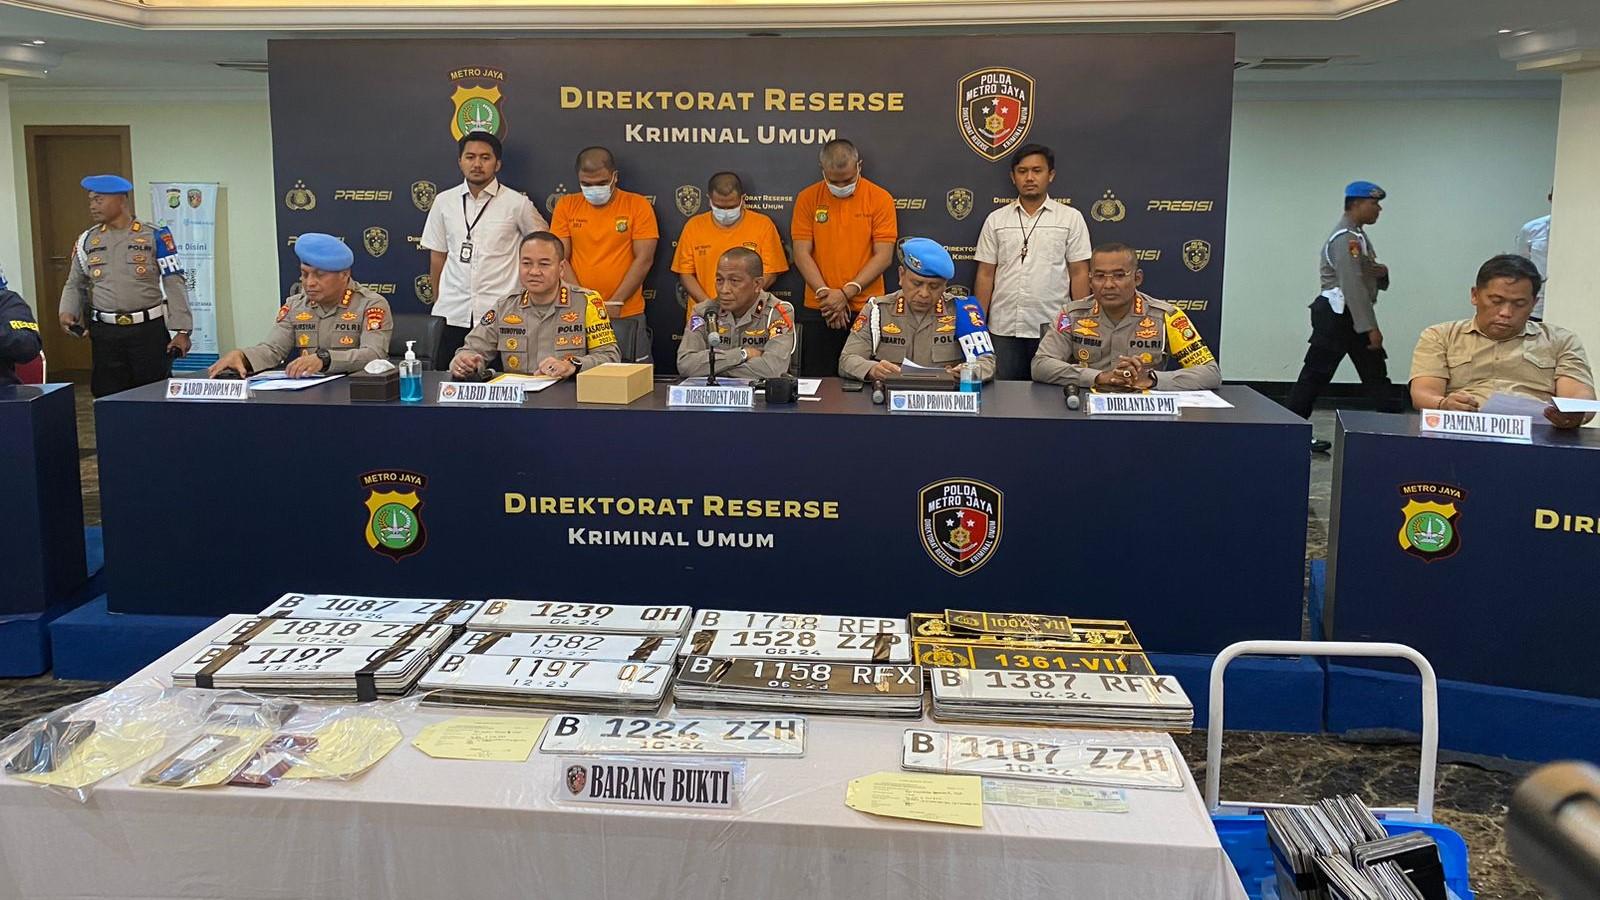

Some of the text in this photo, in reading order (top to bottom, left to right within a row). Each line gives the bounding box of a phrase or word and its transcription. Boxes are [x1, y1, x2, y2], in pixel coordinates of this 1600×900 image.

[450, 68, 504, 81] METRO JAYA
[981, 73, 1011, 85] POLDA
[560, 86, 904, 112] DIREKTORAT RESERSE
[966, 84, 1025, 101] METRO JAYA
[624, 123, 837, 145] KRIMINAL UMUM
[334, 190, 393, 201] PRESISI
[892, 199, 927, 210] SISI
[1147, 200, 1214, 212] PRESISI
[335, 323, 360, 331] POLRI
[557, 324, 583, 334] POLRI
[1129, 340, 1161, 349] POLRI
[182, 380, 242, 398] KABID PROPAM PMJ
[456, 385, 518, 402] KABID HUMAS
[685, 389, 749, 406] DIRREGIDENT POLRI
[907, 394, 975, 411] KARO PROVOS POLRI
[1107, 397, 1176, 414] DIRLANTAS PMJ
[1442, 413, 1525, 436] PAMINAL POLRI
[364, 473, 422, 486] METRO JAYA
[943, 485, 977, 497] POLDA
[1403, 485, 1461, 499] METRO JAYA
[504, 493, 839, 519] DIREKTORAT RESERSE
[928, 496, 993, 514] METRO JAYA
[568, 527, 774, 548] KRIMINAL UMUM
[278, 596, 305, 608] B
[317, 598, 400, 612] 1087
[483, 600, 682, 621] B 1239 QH
[272, 621, 362, 636] 1818
[701, 611, 896, 633] B 1758 RFP
[528, 634, 606, 651] 1582
[730, 631, 817, 648] 1528
[248, 648, 345, 664] 1197
[994, 653, 1128, 672] 1361-VII
[438, 655, 465, 673] B
[505, 657, 590, 679] 1197
[690, 657, 917, 685] B 1158 RFX
[941, 669, 1177, 694] B 1387 RFK
[554, 716, 797, 741] B 1224 ZZH
[911, 732, 1169, 772] B 1107 ZZH
[589, 765, 731, 805] BARANG BUKTI
